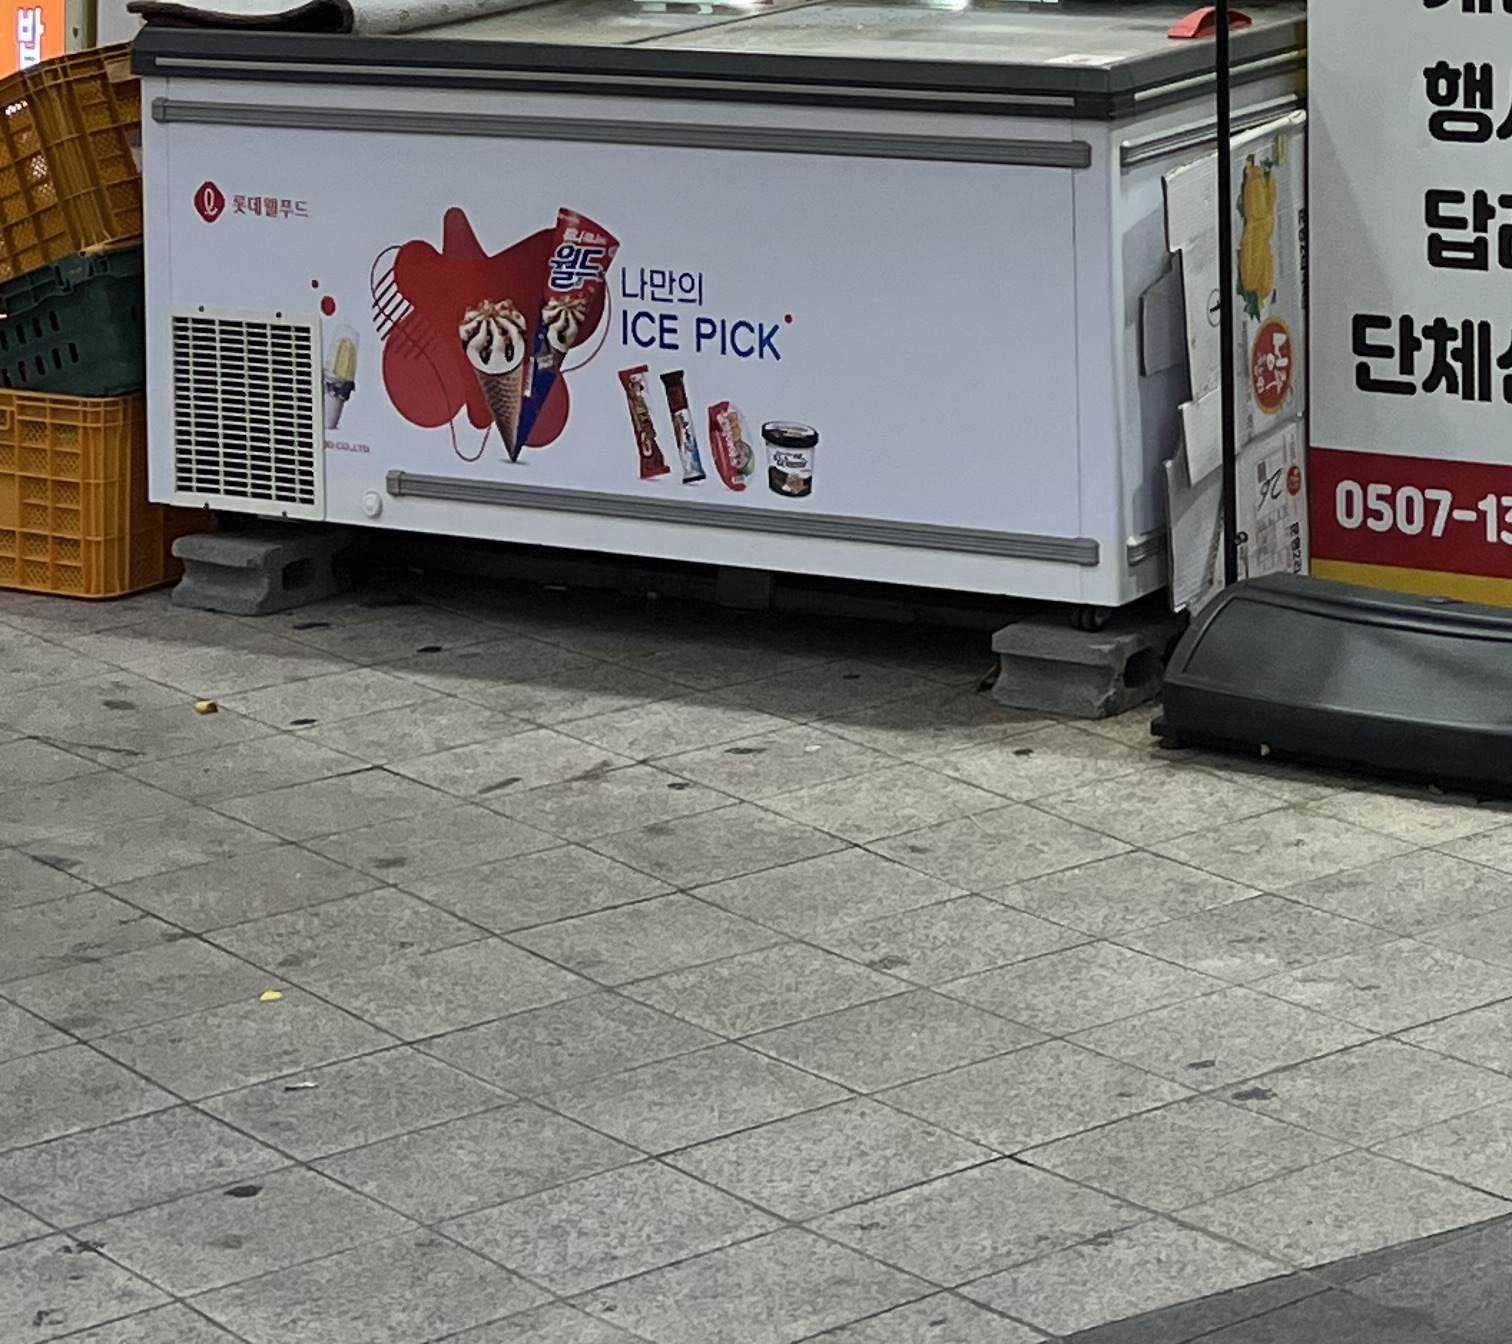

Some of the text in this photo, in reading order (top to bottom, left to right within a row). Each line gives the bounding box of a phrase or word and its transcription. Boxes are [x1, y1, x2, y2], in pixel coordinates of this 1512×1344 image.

[233, 194, 309, 219] 롯데웰푸드
[548, 242, 606, 292] 월드
[622, 267, 703, 306] 나만의
[622, 310, 781, 361] ICE PICK
